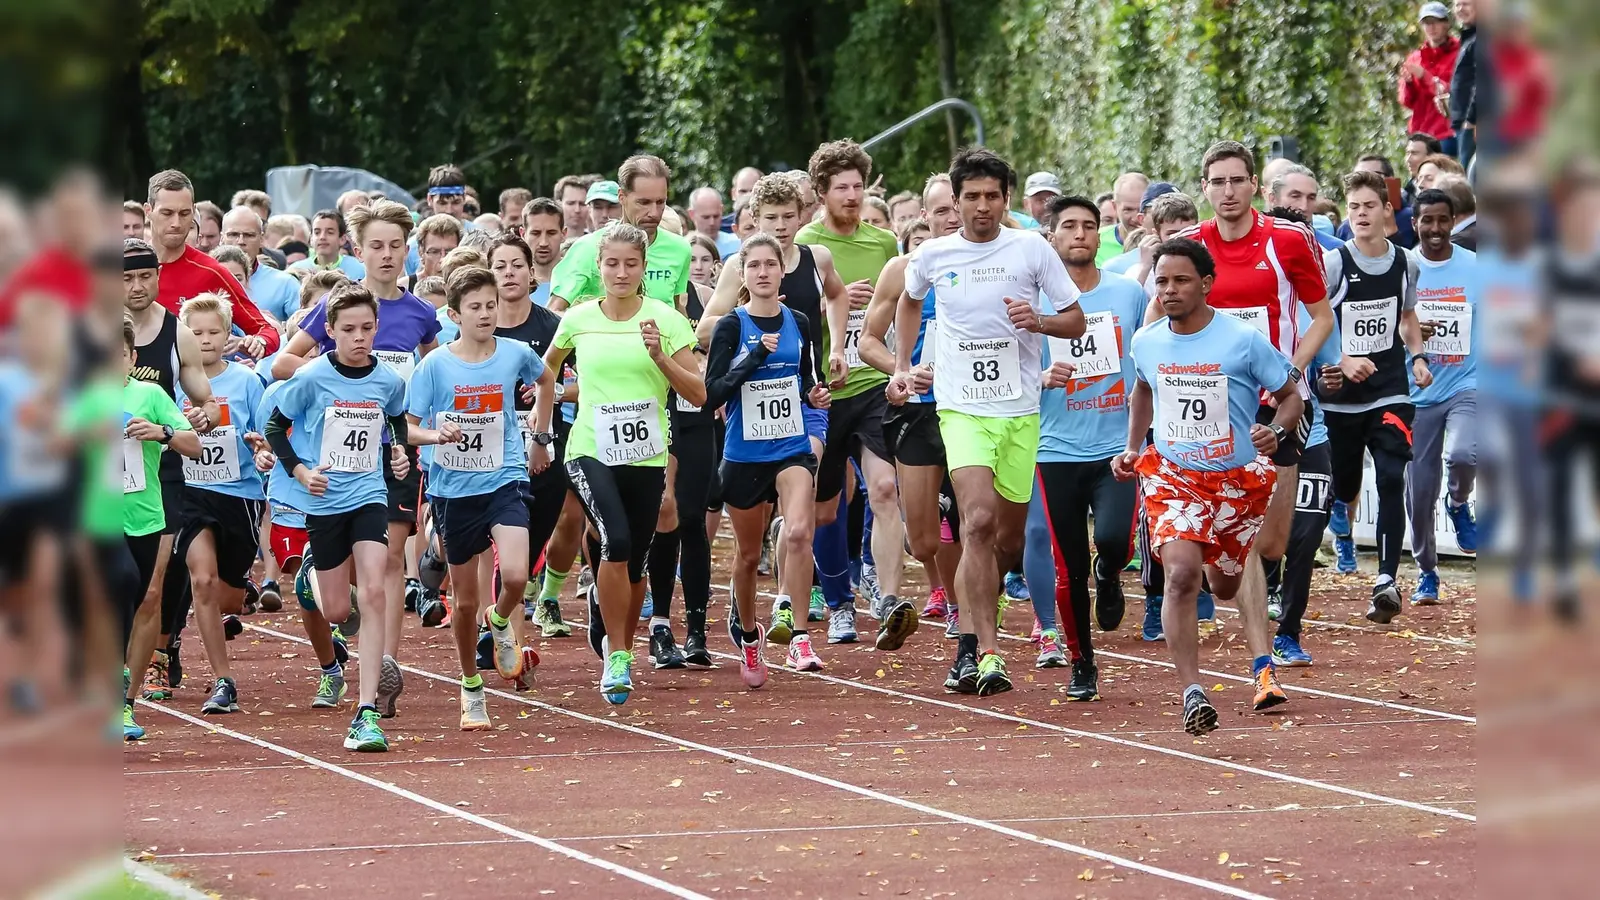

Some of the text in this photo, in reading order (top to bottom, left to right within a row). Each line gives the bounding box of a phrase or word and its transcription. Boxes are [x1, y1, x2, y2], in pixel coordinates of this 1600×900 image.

[971, 267, 1006, 275] REUTTER
[971, 275, 1018, 283] IMMOBILIEN
[1350, 301, 1391, 312] Schweiger
[1421, 303, 1466, 312] Schweiger
[1354, 317, 1387, 337] 666
[1427, 319, 1460, 338] 54
[959, 339, 1010, 351] Schweiger
[1070, 335, 1097, 358] 84
[1349, 336, 1389, 352] SILENCA
[973, 360, 1000, 382] 83
[1158, 362, 1221, 375] Schweiger
[454, 383, 503, 394] Schweiger
[749, 380, 793, 392] Schweiger
[962, 382, 1014, 400] SILENCA
[1165, 376, 1218, 389] Schweiger
[601, 401, 651, 414] Schweiger
[756, 398, 791, 420] 109
[1066, 393, 1125, 411] ForstLauf
[1178, 398, 1207, 421] 79
[334, 409, 380, 421] Schweiger
[445, 413, 496, 425] Schweiger
[609, 420, 649, 444] 196
[752, 419, 798, 437] SILENCA
[1167, 422, 1221, 440] SILENCA
[343, 430, 368, 451] 46
[456, 433, 483, 452] 34
[328, 451, 372, 470] SILENCA
[443, 452, 495, 470] SILENCA
[606, 442, 656, 463] SILENCA
[185, 466, 232, 481] SILENCA
[282, 537, 290, 551] 1
